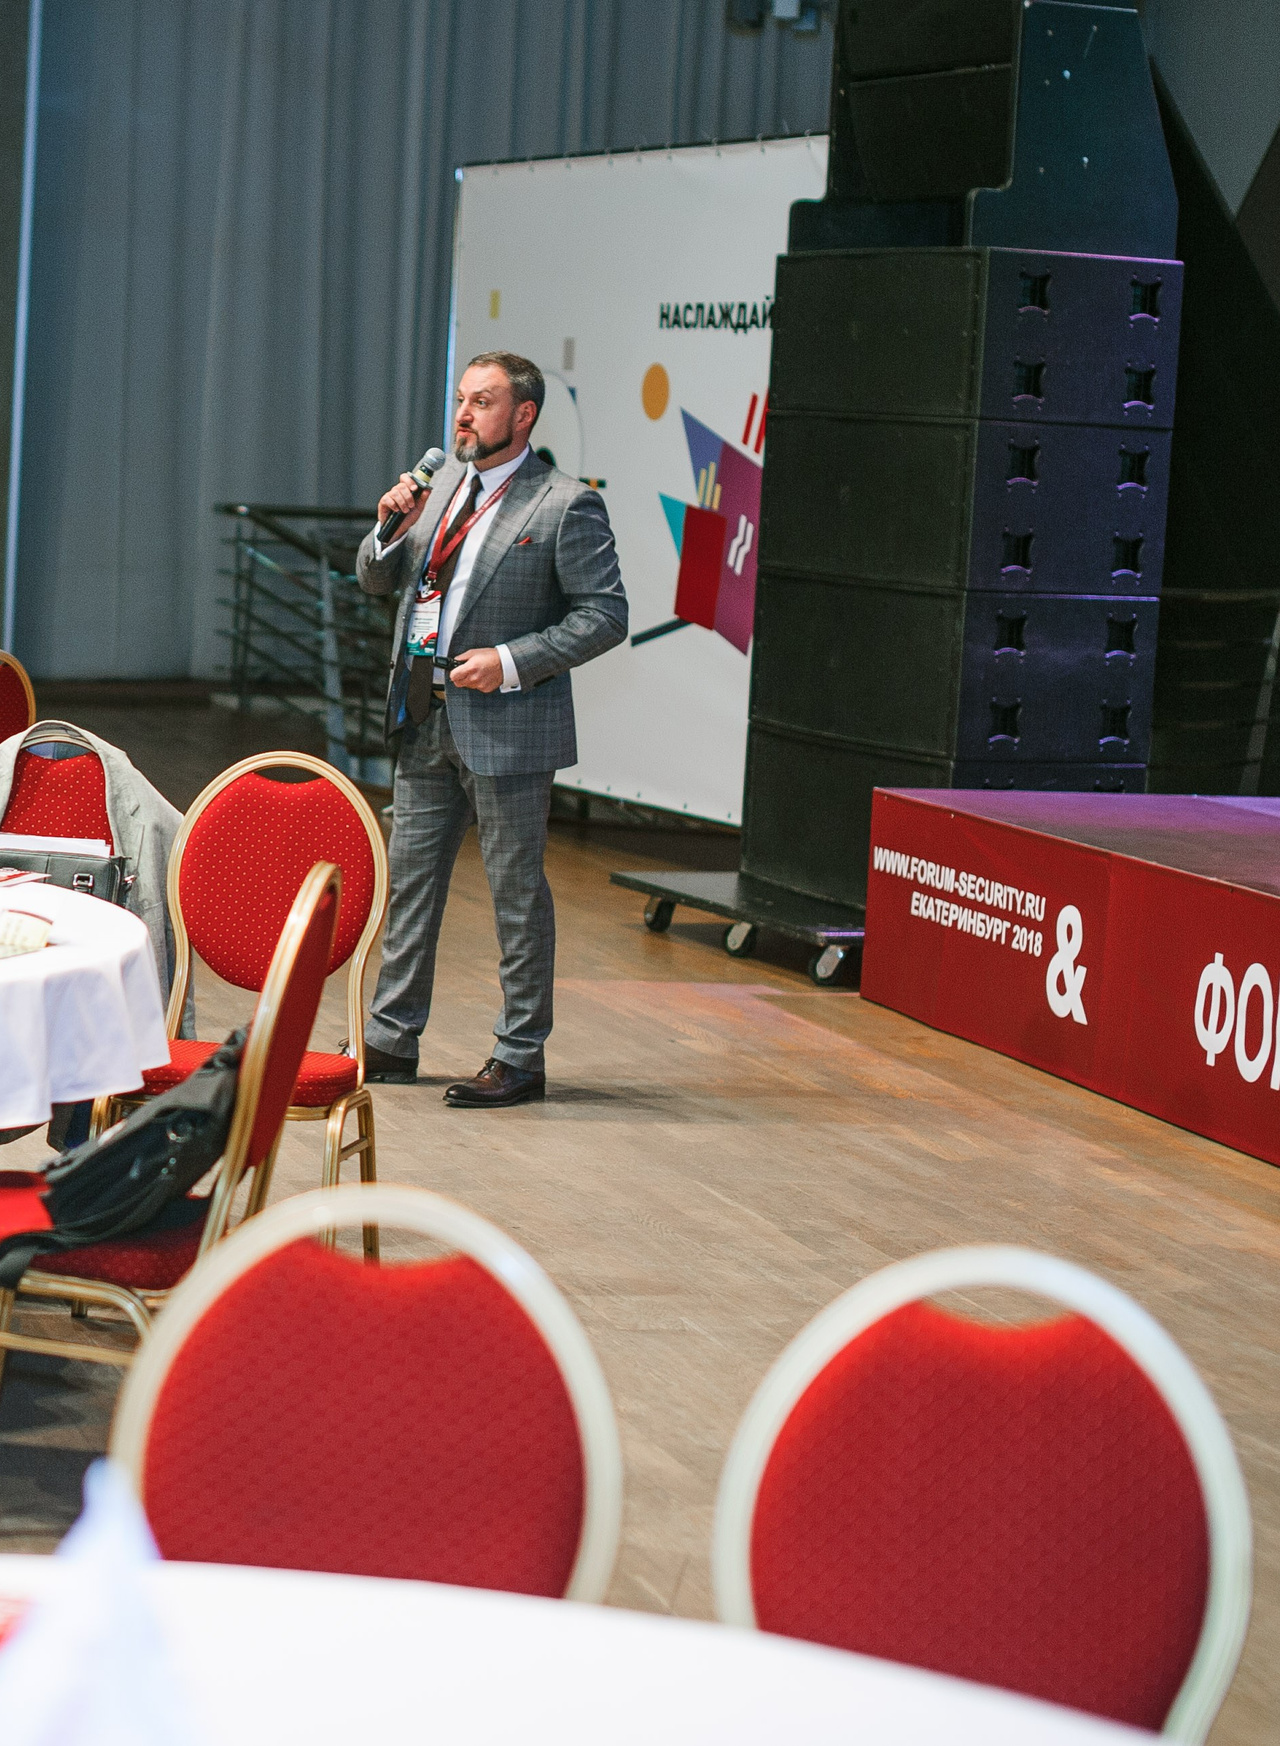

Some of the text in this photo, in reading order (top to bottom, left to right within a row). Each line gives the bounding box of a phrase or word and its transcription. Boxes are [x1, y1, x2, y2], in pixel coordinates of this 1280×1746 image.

[873, 846, 1046, 922] WWW.FORUM-SECURITY.RU
[910, 891, 1043, 958] ЕКАТЕРИНБУРГ 2018
[1045, 904, 1088, 1026] &
